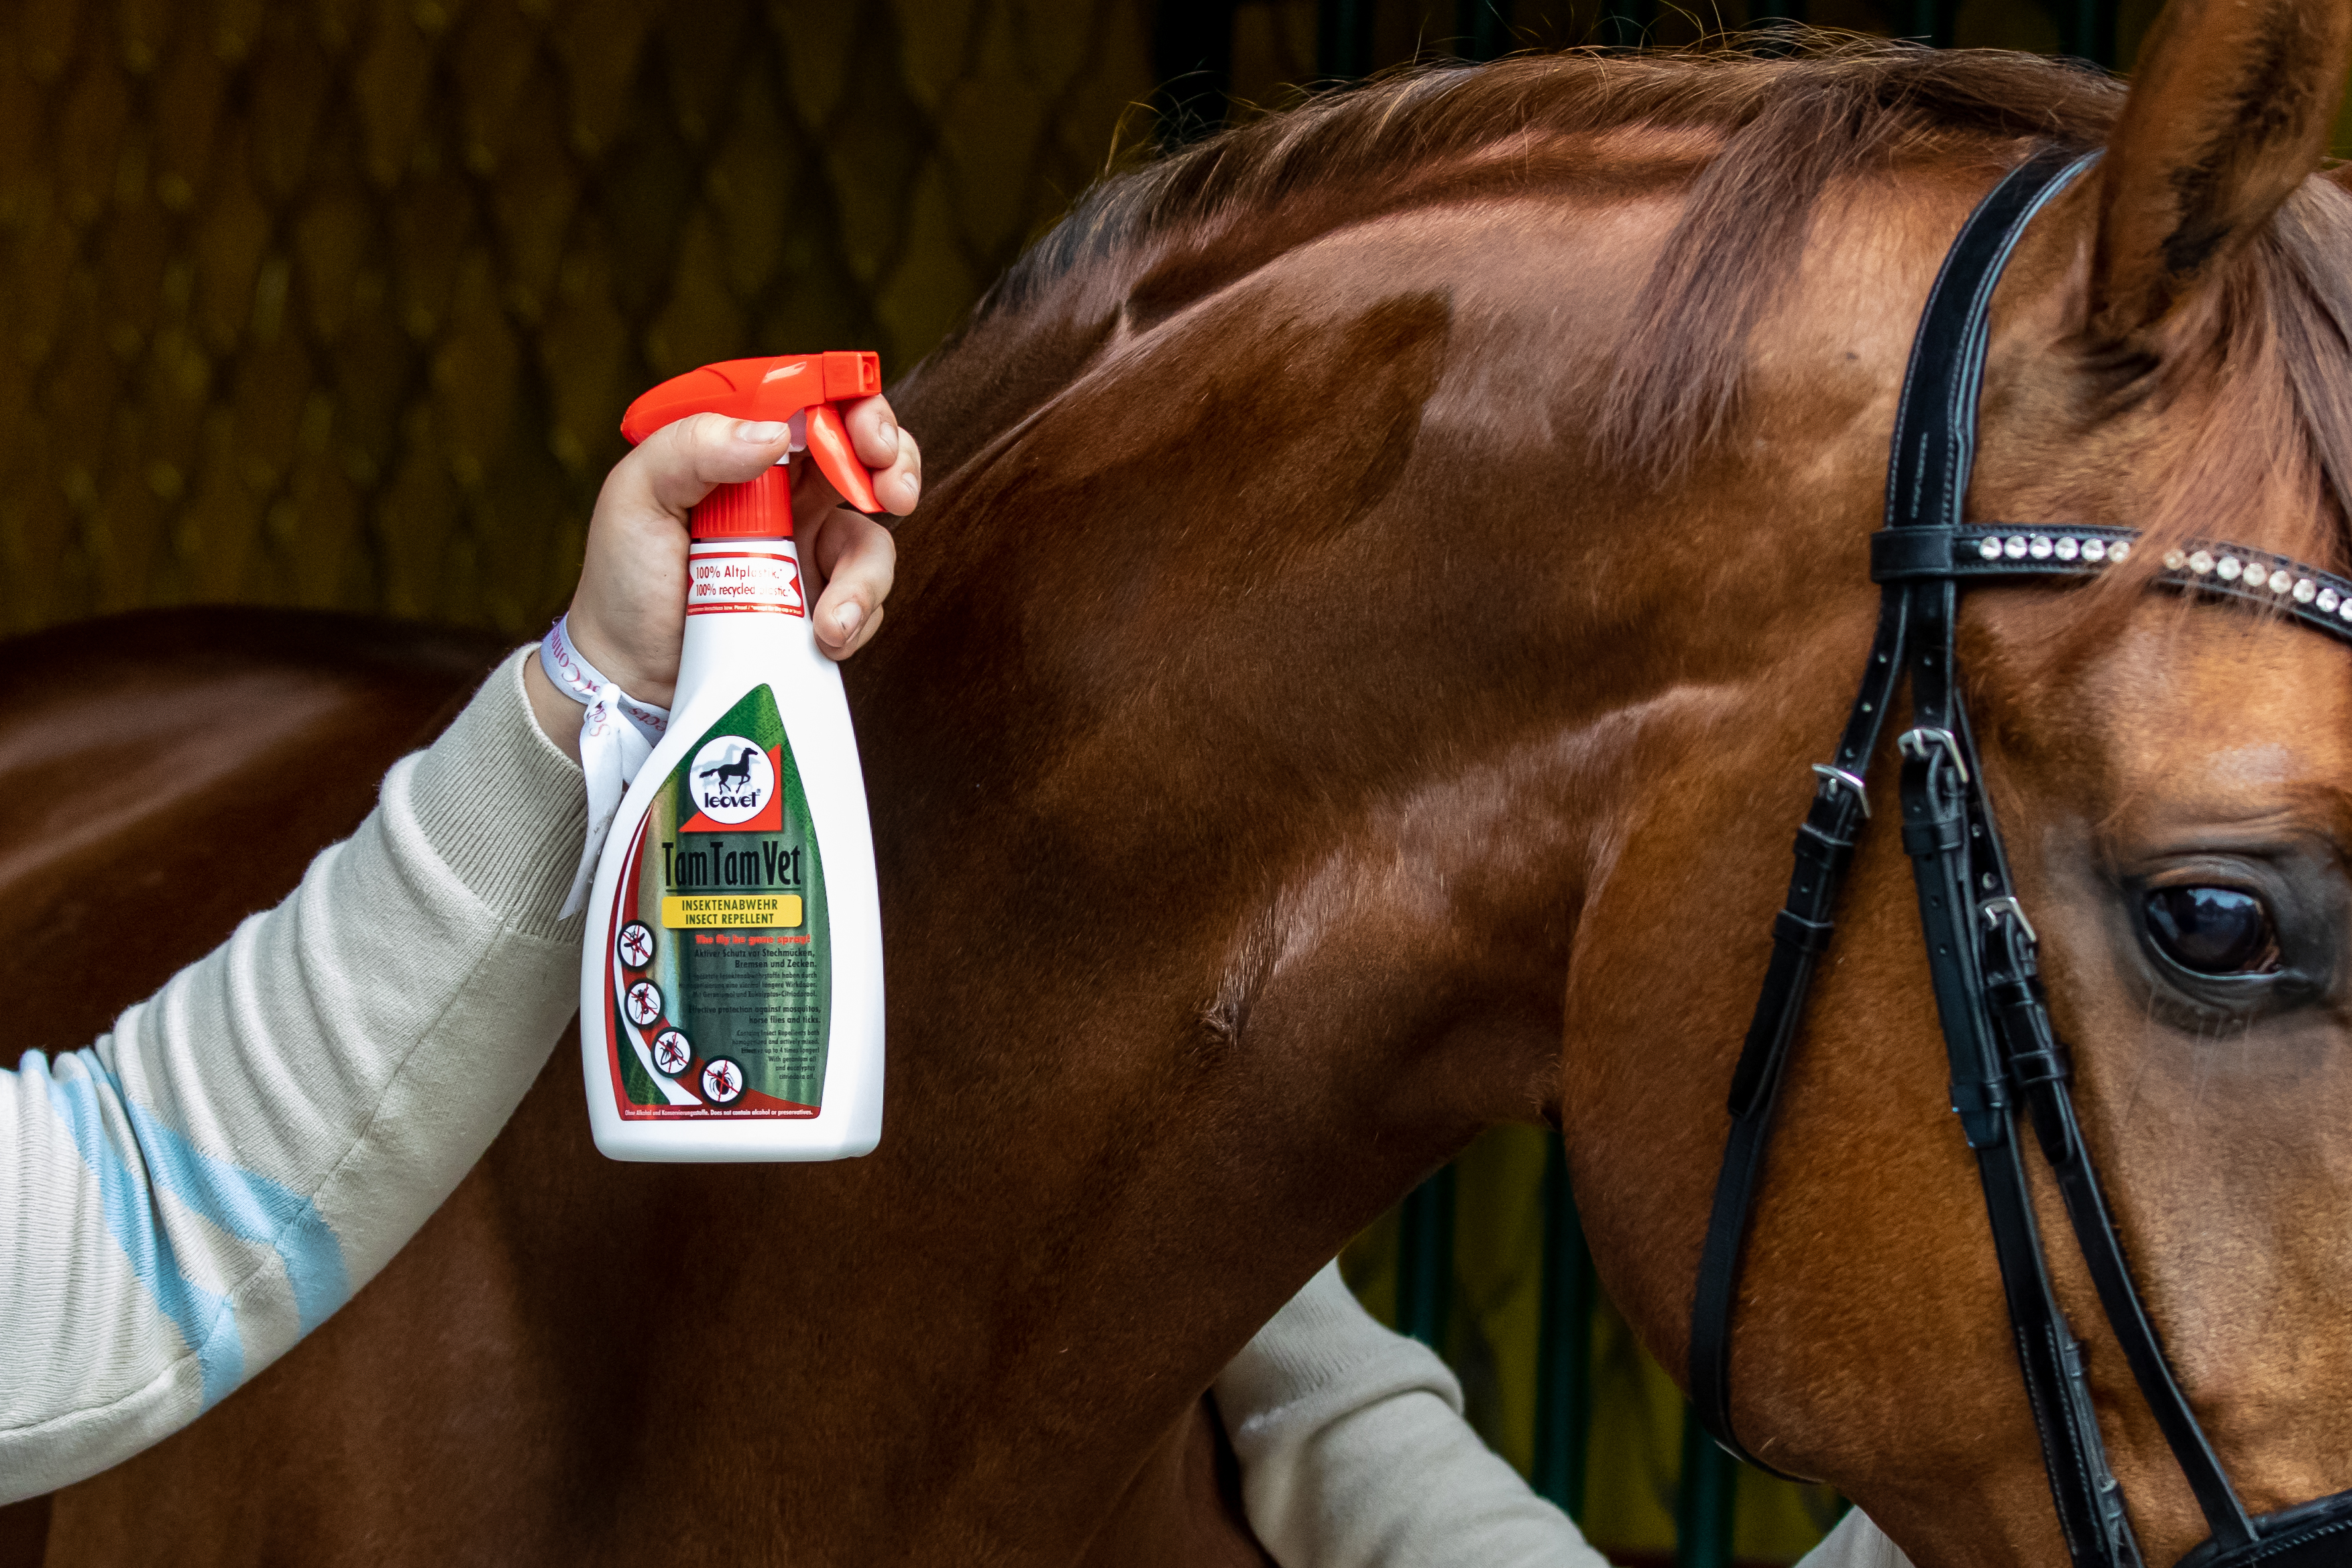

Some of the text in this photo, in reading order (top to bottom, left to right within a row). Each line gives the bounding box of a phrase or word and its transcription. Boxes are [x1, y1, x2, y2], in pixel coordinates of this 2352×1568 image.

[696, 566, 720, 579] 100%
[696, 583, 716, 596] 100%
[719, 582, 755, 597] recycled
[682, 899, 778, 911] INSEKTENABWEHR
[685, 913, 774, 925] INSECT REPELLENT
[777, 934, 811, 946] spray!
[695, 948, 720, 957] Aktiver
[722, 948, 746, 957] Schutz
[762, 948, 815, 958] Stechmücken,
[735, 959, 817, 968] Bremsen und Zecken.
[754, 1005, 781, 1014] against
[783, 1005, 821, 1014] mosquitos,
[749, 1015, 821, 1023] horse flies and ticks.
